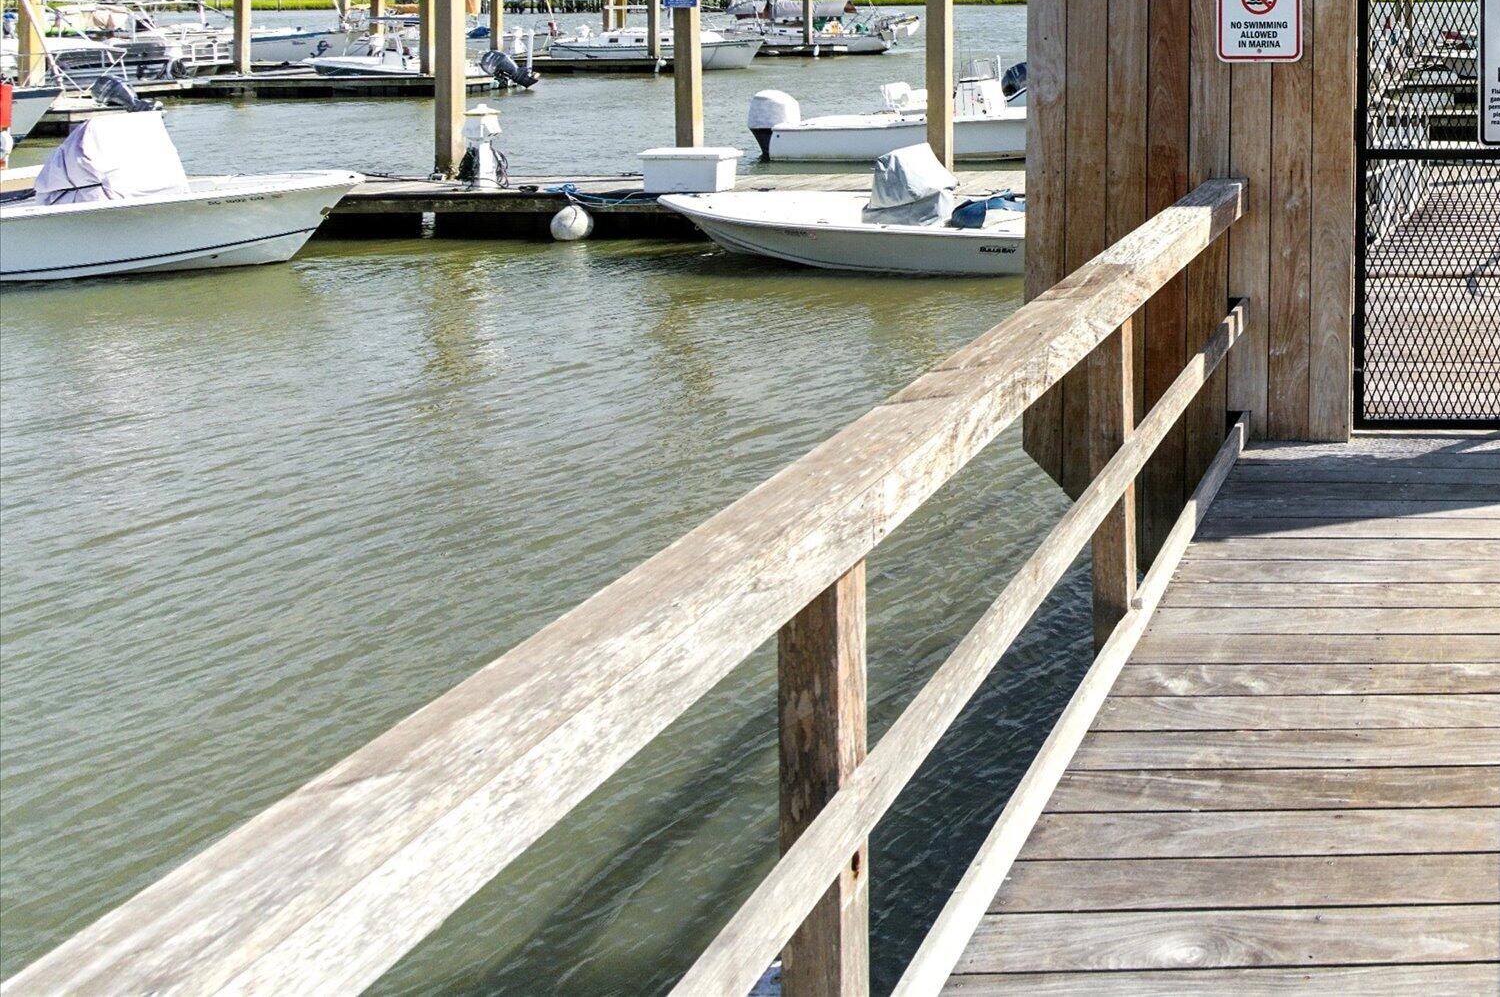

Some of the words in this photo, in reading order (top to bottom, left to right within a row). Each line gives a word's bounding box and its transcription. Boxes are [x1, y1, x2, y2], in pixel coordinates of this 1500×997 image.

[1230, 21, 1242, 30] NO
[1243, 21, 1289, 30] SWIMMING
[1240, 30, 1278, 39] ALLOWED
[1238, 40, 1246, 48] IN
[1248, 40, 1281, 49] MARINA
